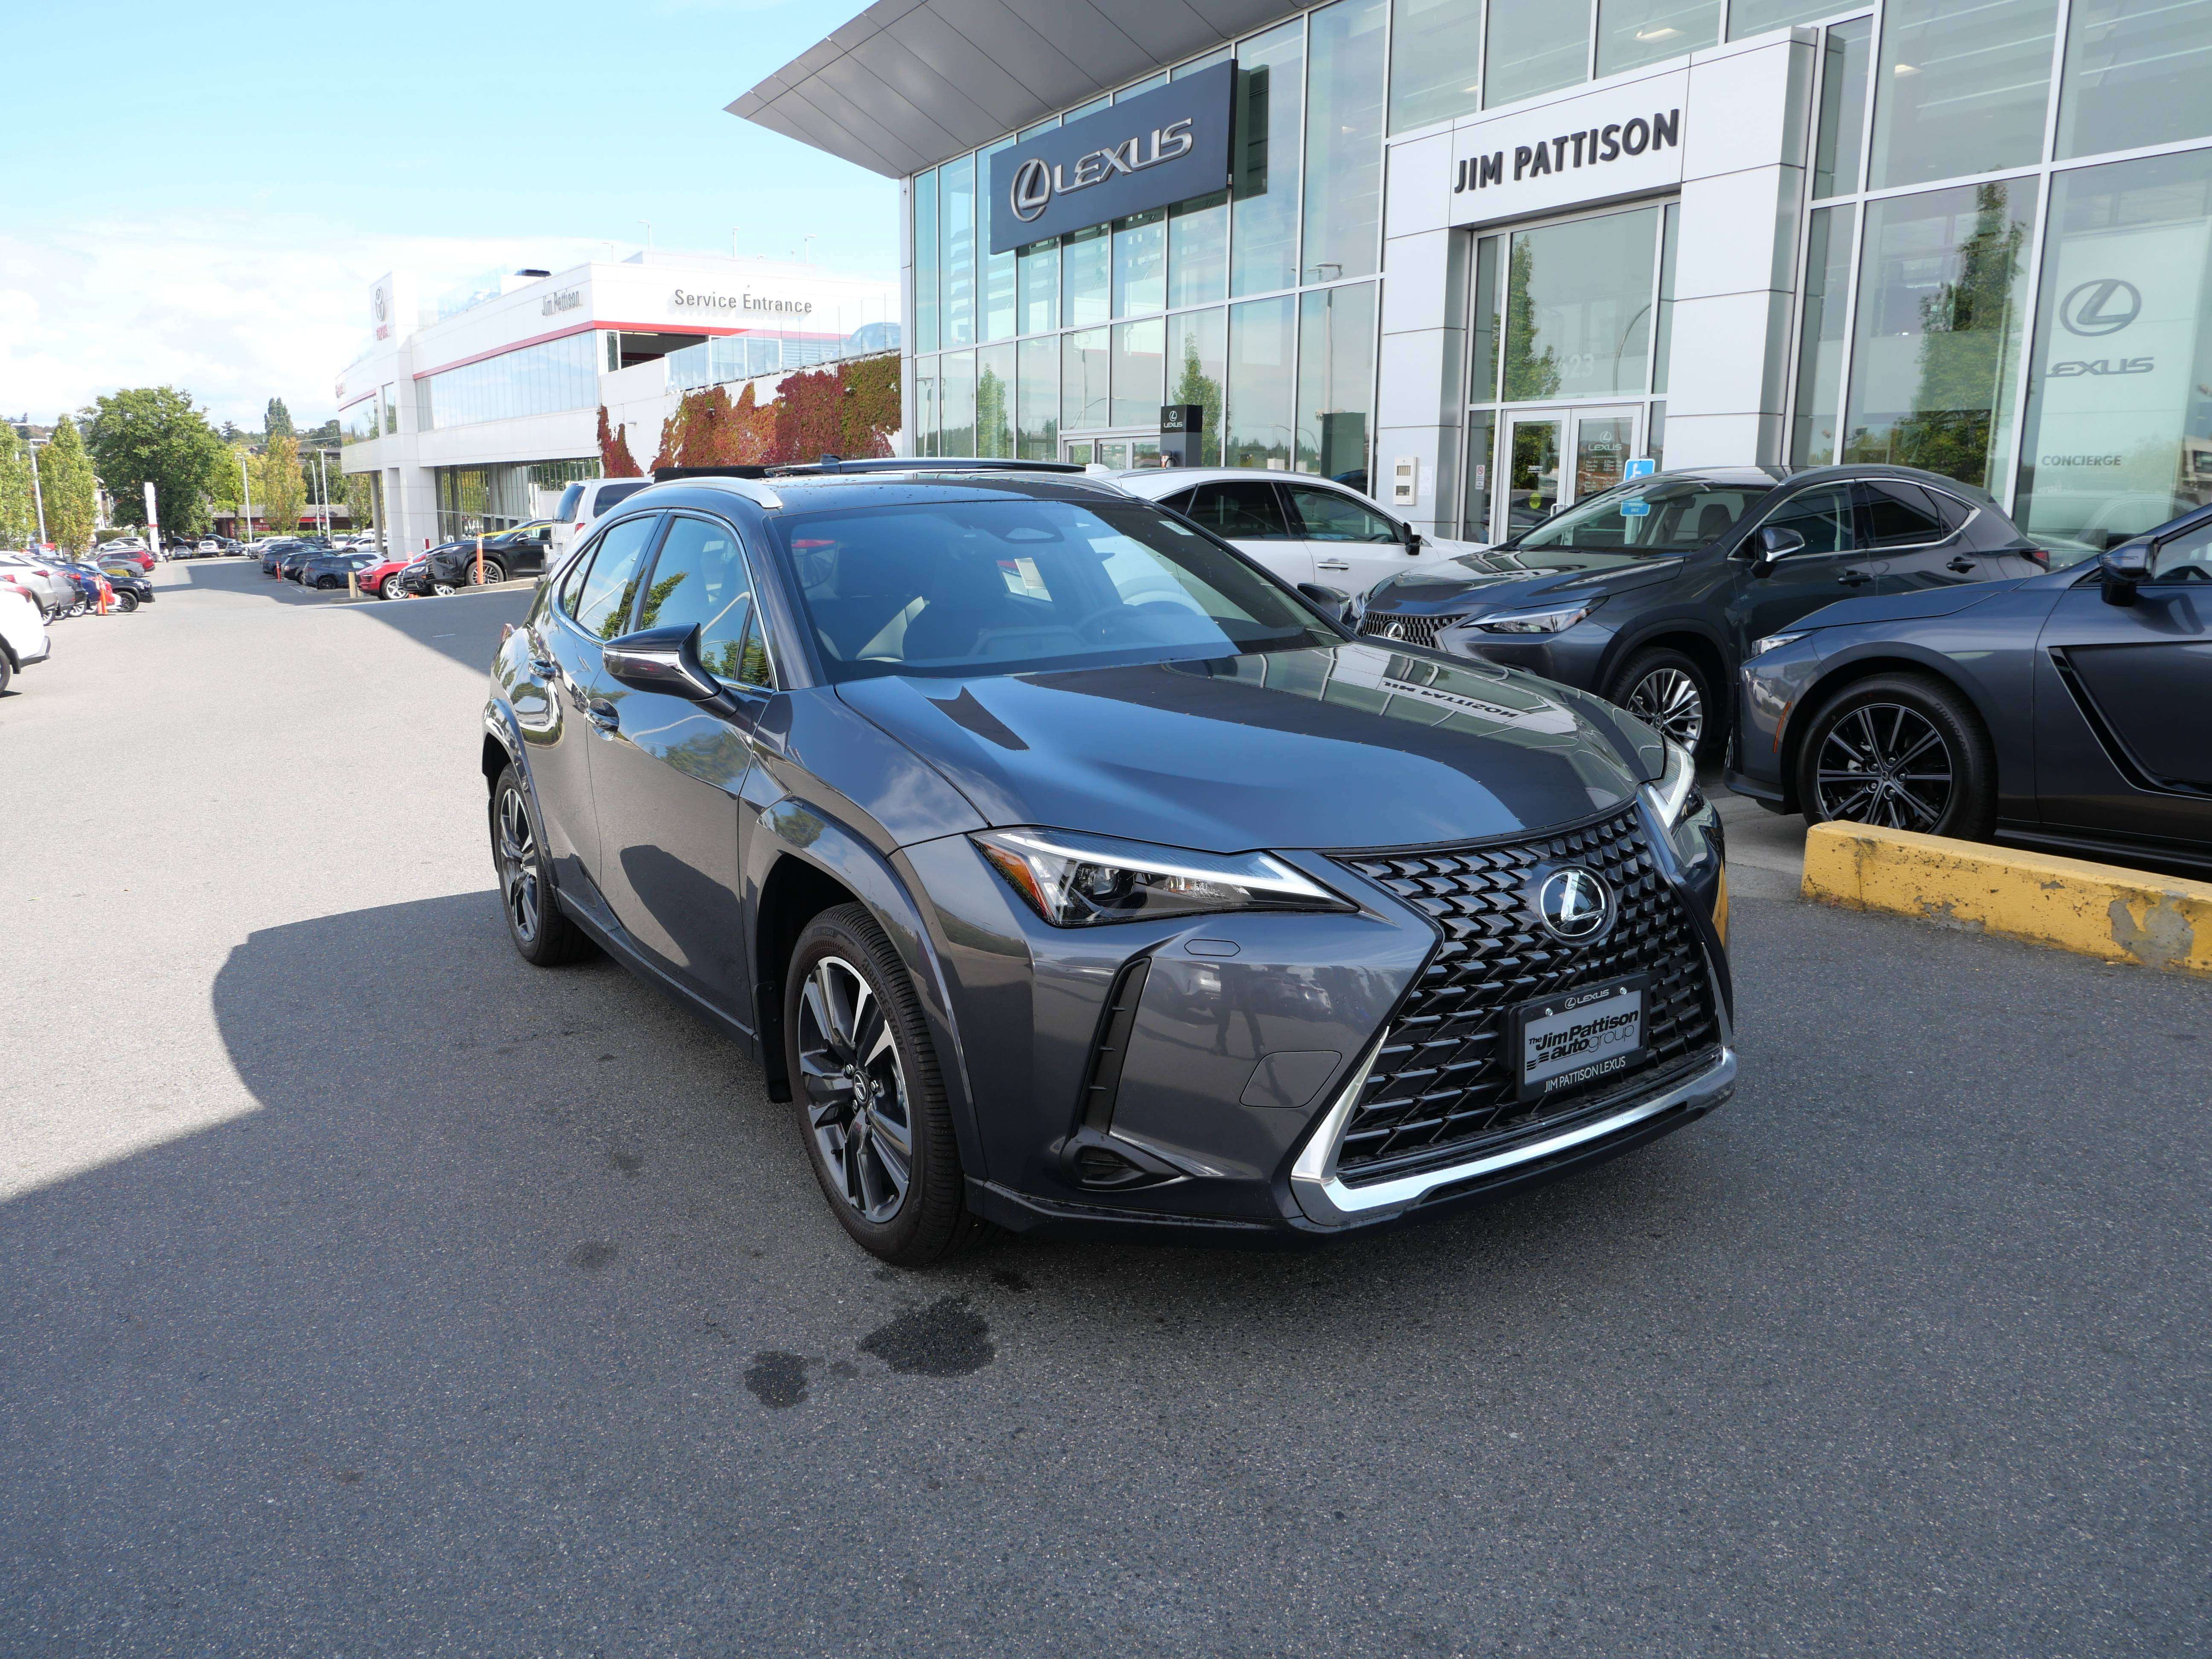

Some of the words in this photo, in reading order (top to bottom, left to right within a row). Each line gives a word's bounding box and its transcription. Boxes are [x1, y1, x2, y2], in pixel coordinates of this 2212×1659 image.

[1054, 118, 1193, 196] LEXUS
[1454, 151, 1503, 194] JIM
[1513, 108, 1679, 181] PATTISON
[542, 295, 553, 316] Jim
[553, 288, 580, 314] Pattison
[674, 289, 737, 309] Service
[742, 293, 812, 314] Entrance
[2045, 356, 2154, 378] EXUS
[2041, 455, 2122, 466] CONCIERGE
[862, 958, 907, 1055] BRIDGESTONE
[1577, 989, 1610, 1004] LEXUS
[1529, 1036, 1542, 1045] The
[1544, 1078, 1558, 1093] JIM
[1560, 1065, 1599, 1088] PATTISON
[1600, 1056, 1626, 1074] LEXUS
